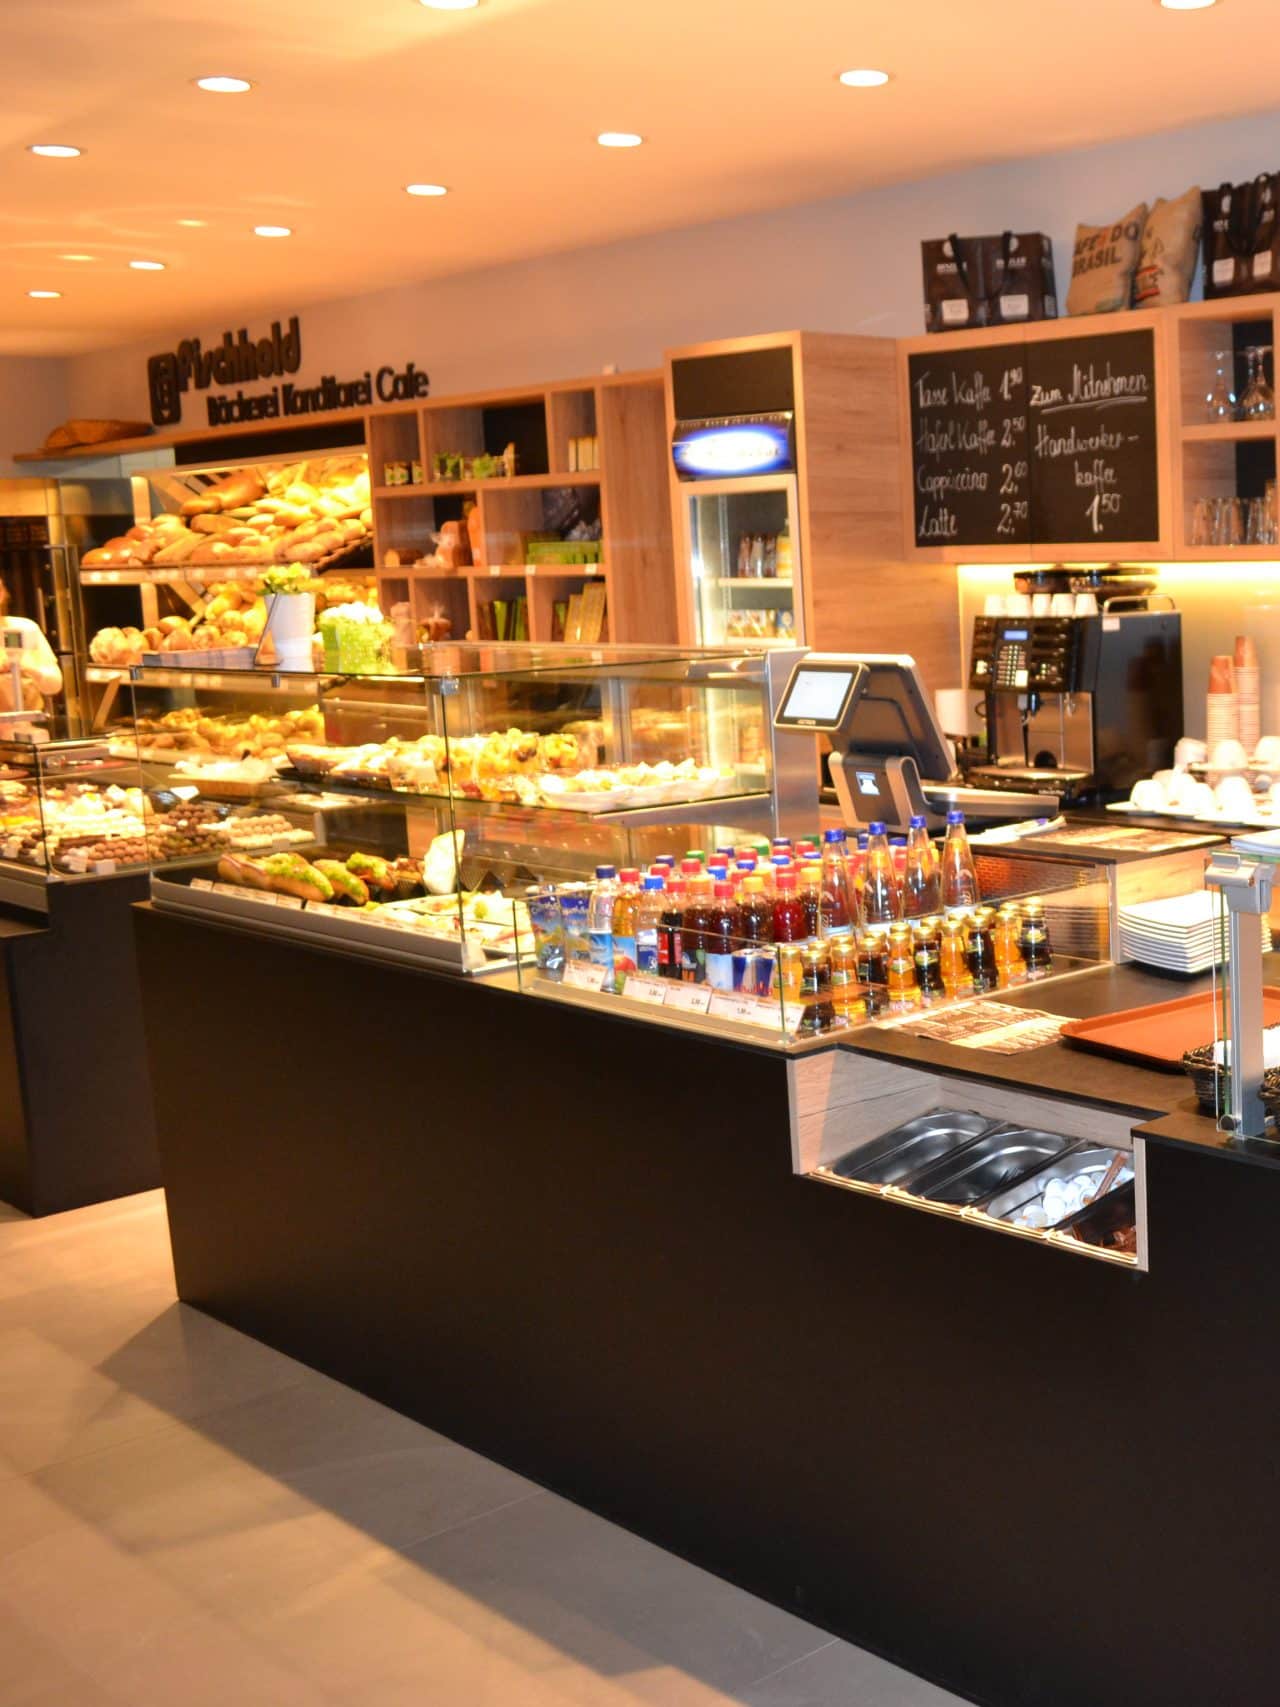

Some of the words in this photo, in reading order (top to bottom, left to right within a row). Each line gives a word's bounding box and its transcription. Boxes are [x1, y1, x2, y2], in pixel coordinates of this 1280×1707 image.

[1030, 385, 1063, 407] Zum
[1067, 361, 1148, 404] Mitnehmen
[918, 505, 958, 537] Latte
